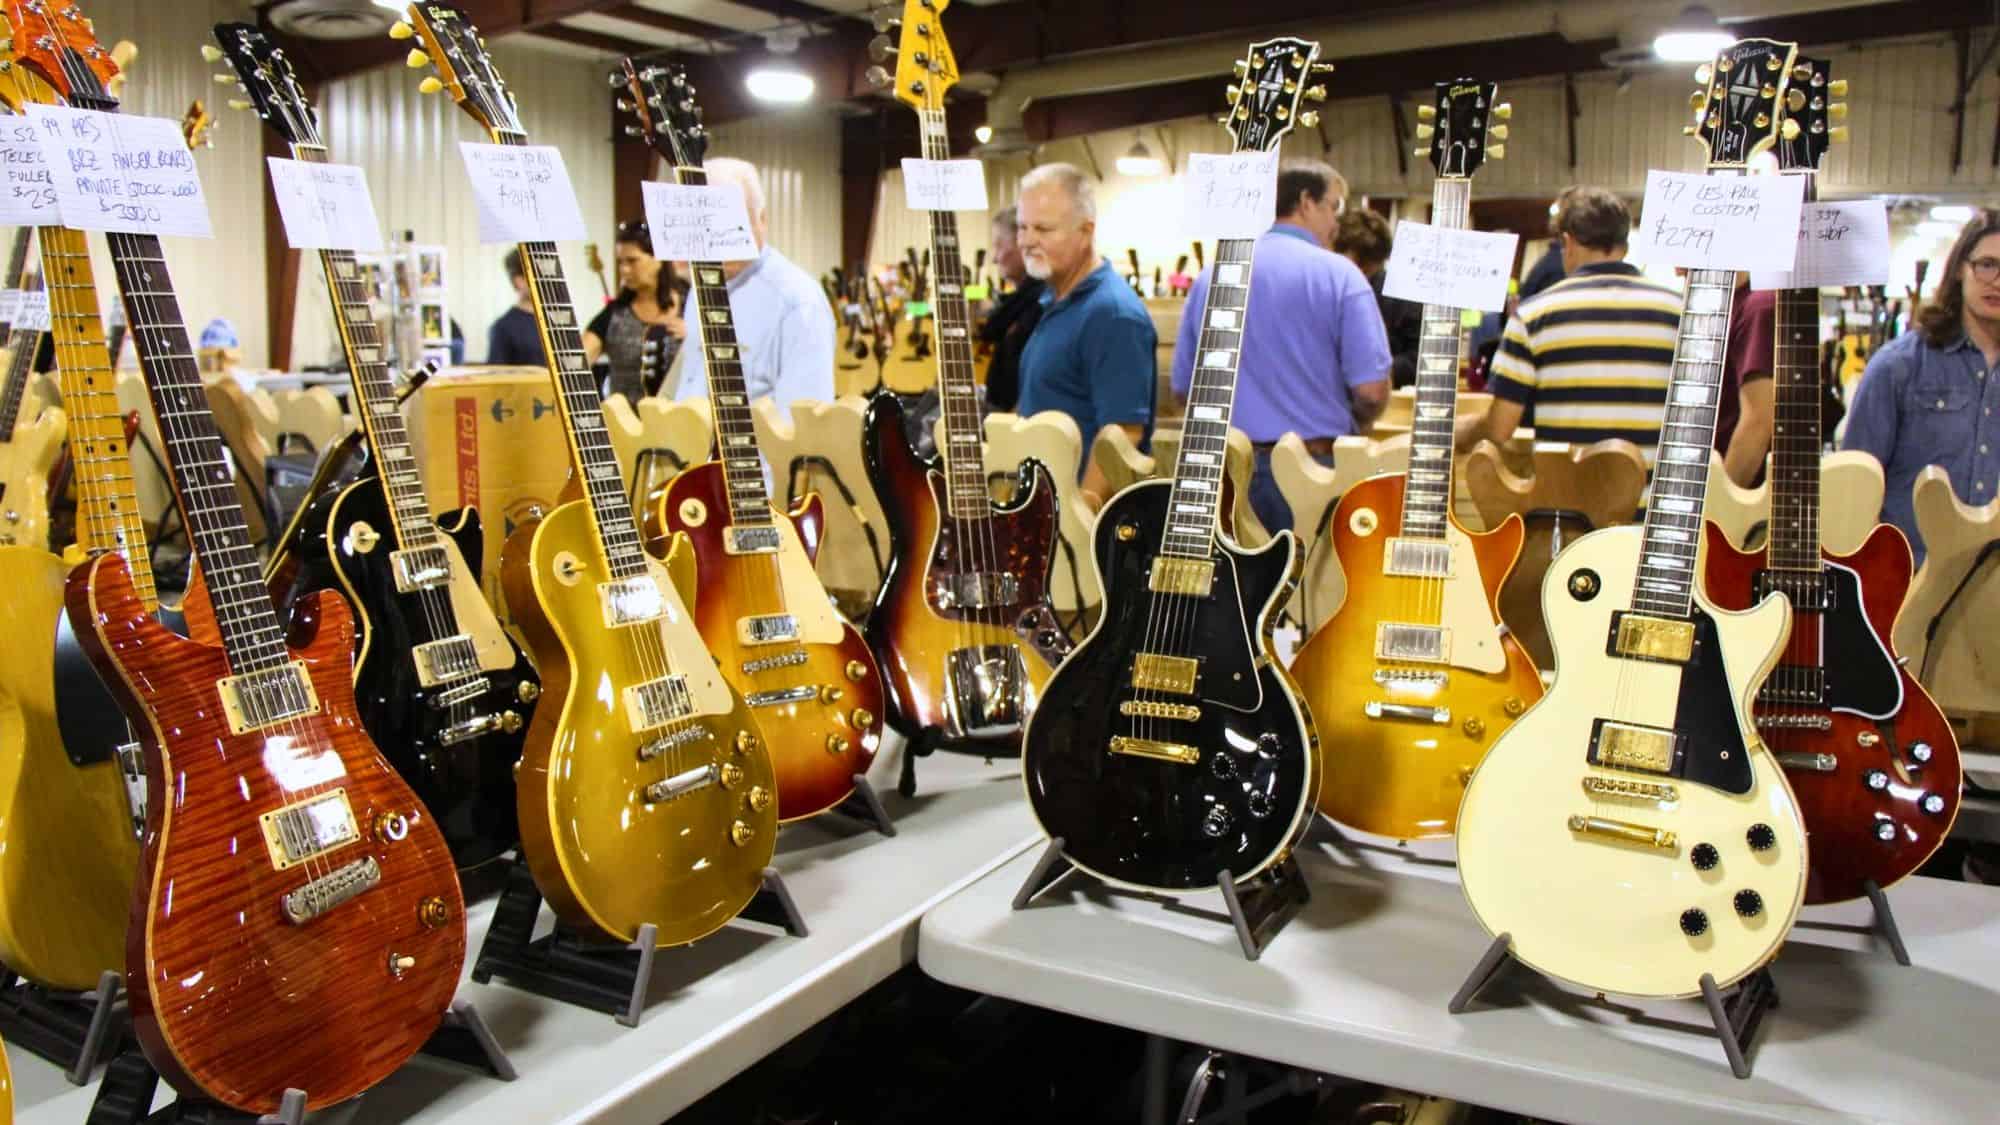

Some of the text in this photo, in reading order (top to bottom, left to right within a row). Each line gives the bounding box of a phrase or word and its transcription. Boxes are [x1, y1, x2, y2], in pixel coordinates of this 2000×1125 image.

[1733, 47, 1774, 63] Gibson
[1658, 177, 1686, 203] 97
[1692, 202, 1760, 223] CUSTOM
[1654, 213, 1714, 255] $2799
[1815, 225, 1849, 241] SHOP
